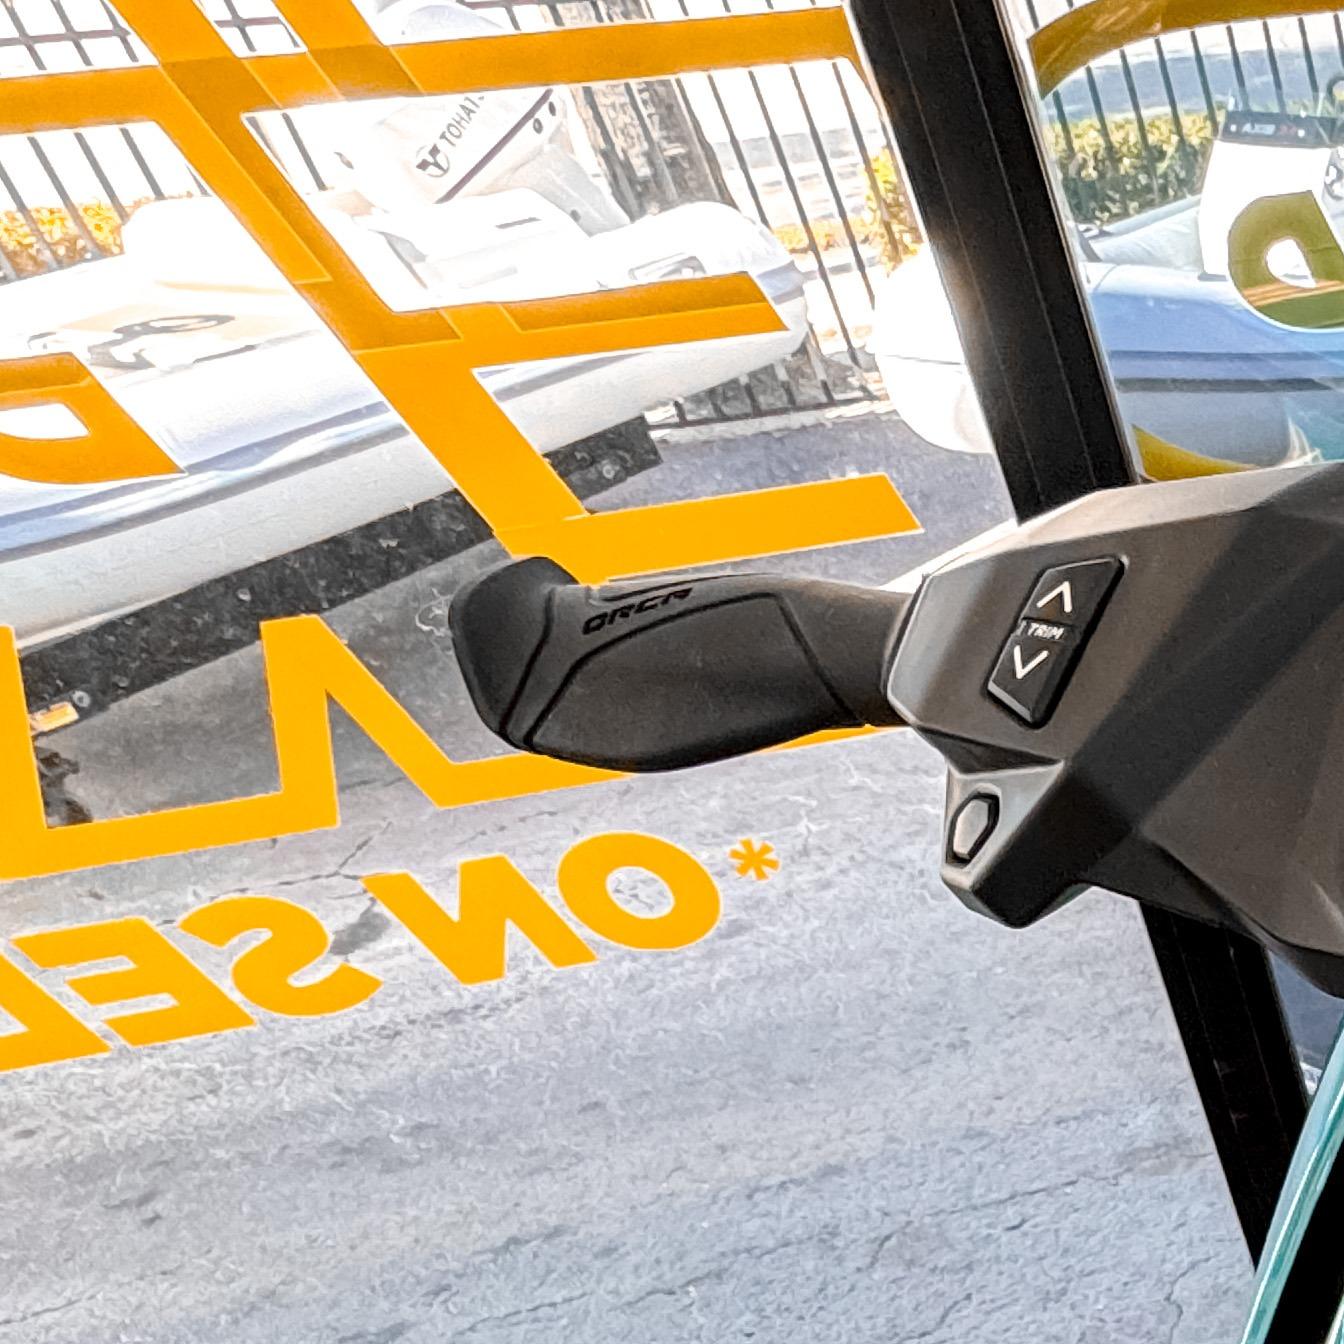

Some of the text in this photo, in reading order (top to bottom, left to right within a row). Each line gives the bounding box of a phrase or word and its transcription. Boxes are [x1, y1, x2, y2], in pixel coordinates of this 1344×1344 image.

[439, 96, 485, 147] TOHAT
[582, 587, 693, 635] ORCA
[1027, 622, 1065, 640] TRIM
